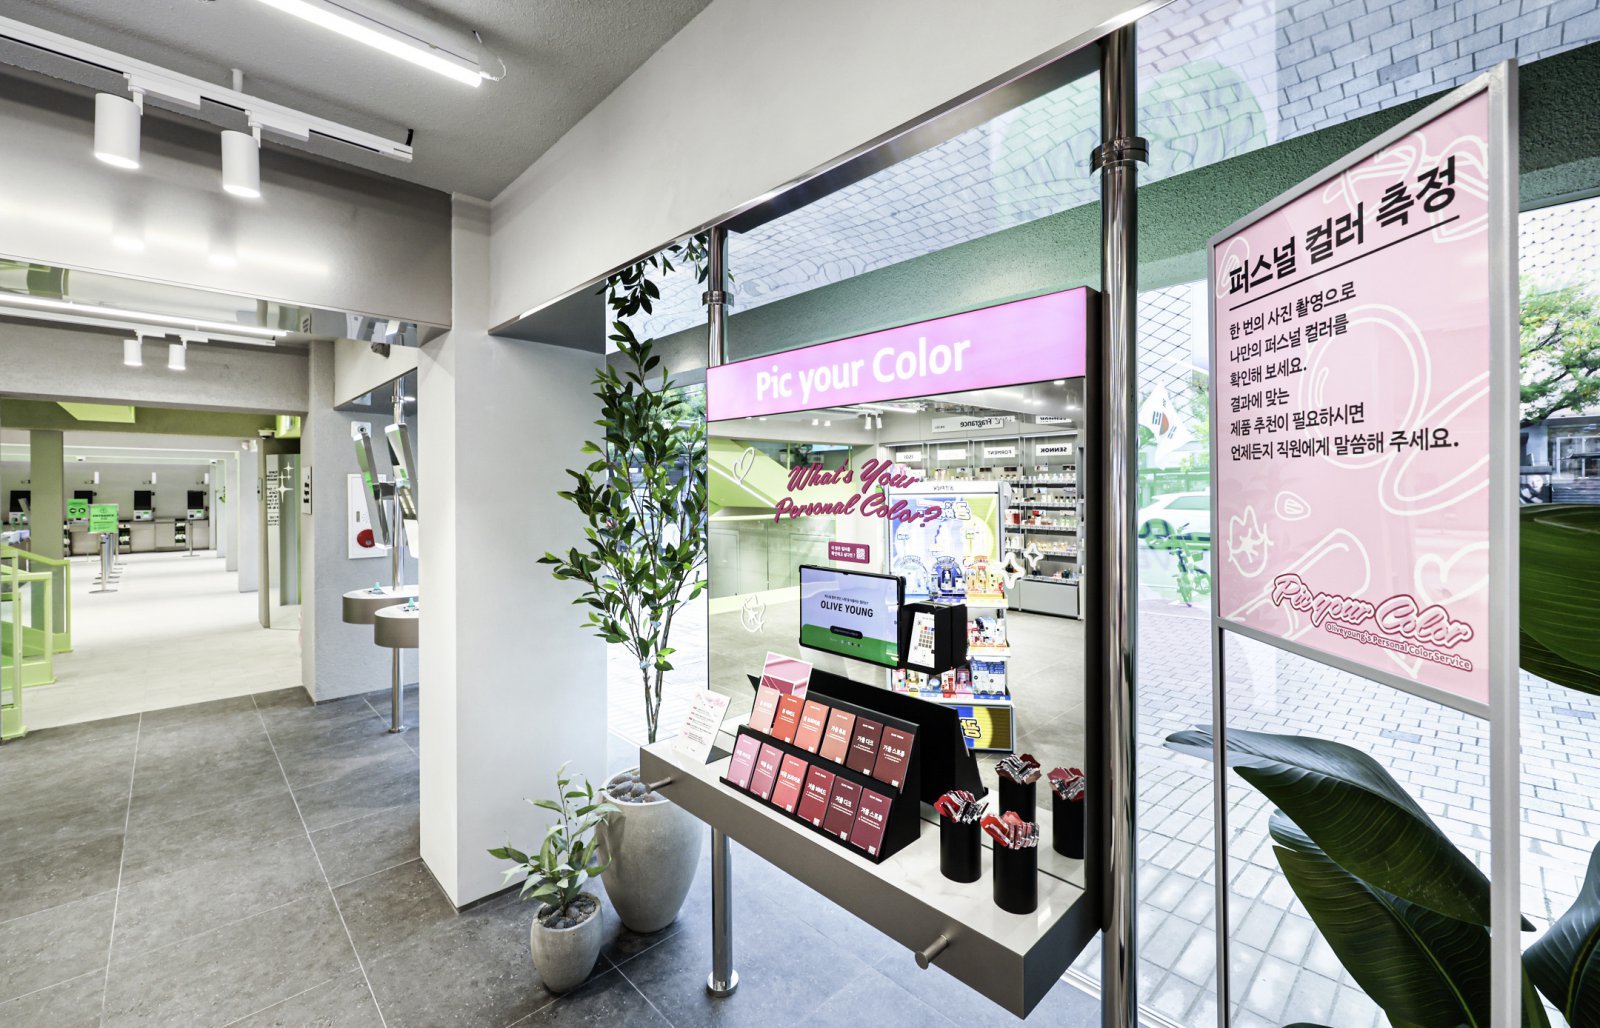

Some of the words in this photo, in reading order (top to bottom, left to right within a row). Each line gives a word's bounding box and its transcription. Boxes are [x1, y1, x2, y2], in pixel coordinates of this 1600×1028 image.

[1229, 236, 1296, 295] 퍼스널
[1305, 202, 1364, 265] 컬러
[1375, 156, 1456, 228] 측정
[1230, 322, 1240, 340] 한
[1242, 313, 1264, 336] 번의
[1268, 302, 1292, 326] 사진
[1296, 281, 1356, 318] 촬영으로
[1230, 340, 1262, 364] 나만의
[1264, 328, 1301, 353] 퍼스널
[1304, 313, 1349, 343] 컬러를
[756, 364, 792, 400] Pic
[798, 360, 864, 404] your
[872, 336, 970, 384] Color
[1230, 366, 1262, 388] 확인해
[1264, 357, 1307, 380] 보세요.
[1230, 391, 1262, 412] 결과에
[1266, 388, 1290, 407] 맞는
[1230, 418, 1252, 436] 제품
[1254, 412, 1288, 434] 추천이
[1292, 402, 1364, 430] 필요하시면
[1230, 442, 1274, 461] 언제든지
[1276, 436, 1330, 458] 직원에게
[1334, 432, 1384, 455] 말씀해
[1389, 428, 1459, 452] 주세요.
[787, 458, 853, 492] What's
[860, 458, 920, 494] Your
[774, 494, 862, 524] Personal
[860, 492, 942, 528] Color?
[820, 600, 843, 612] OLIVE
[845, 604, 874, 618] YOUNG
[1272, 573, 1314, 612] Pic
[1310, 592, 1375, 627] your
[1375, 594, 1474, 648] Color
[1326, 622, 1373, 644] Oliveyoung's
[1373, 635, 1408, 654] Personal
[1408, 644, 1434, 660] Color
[1434, 651, 1473, 672] Service
